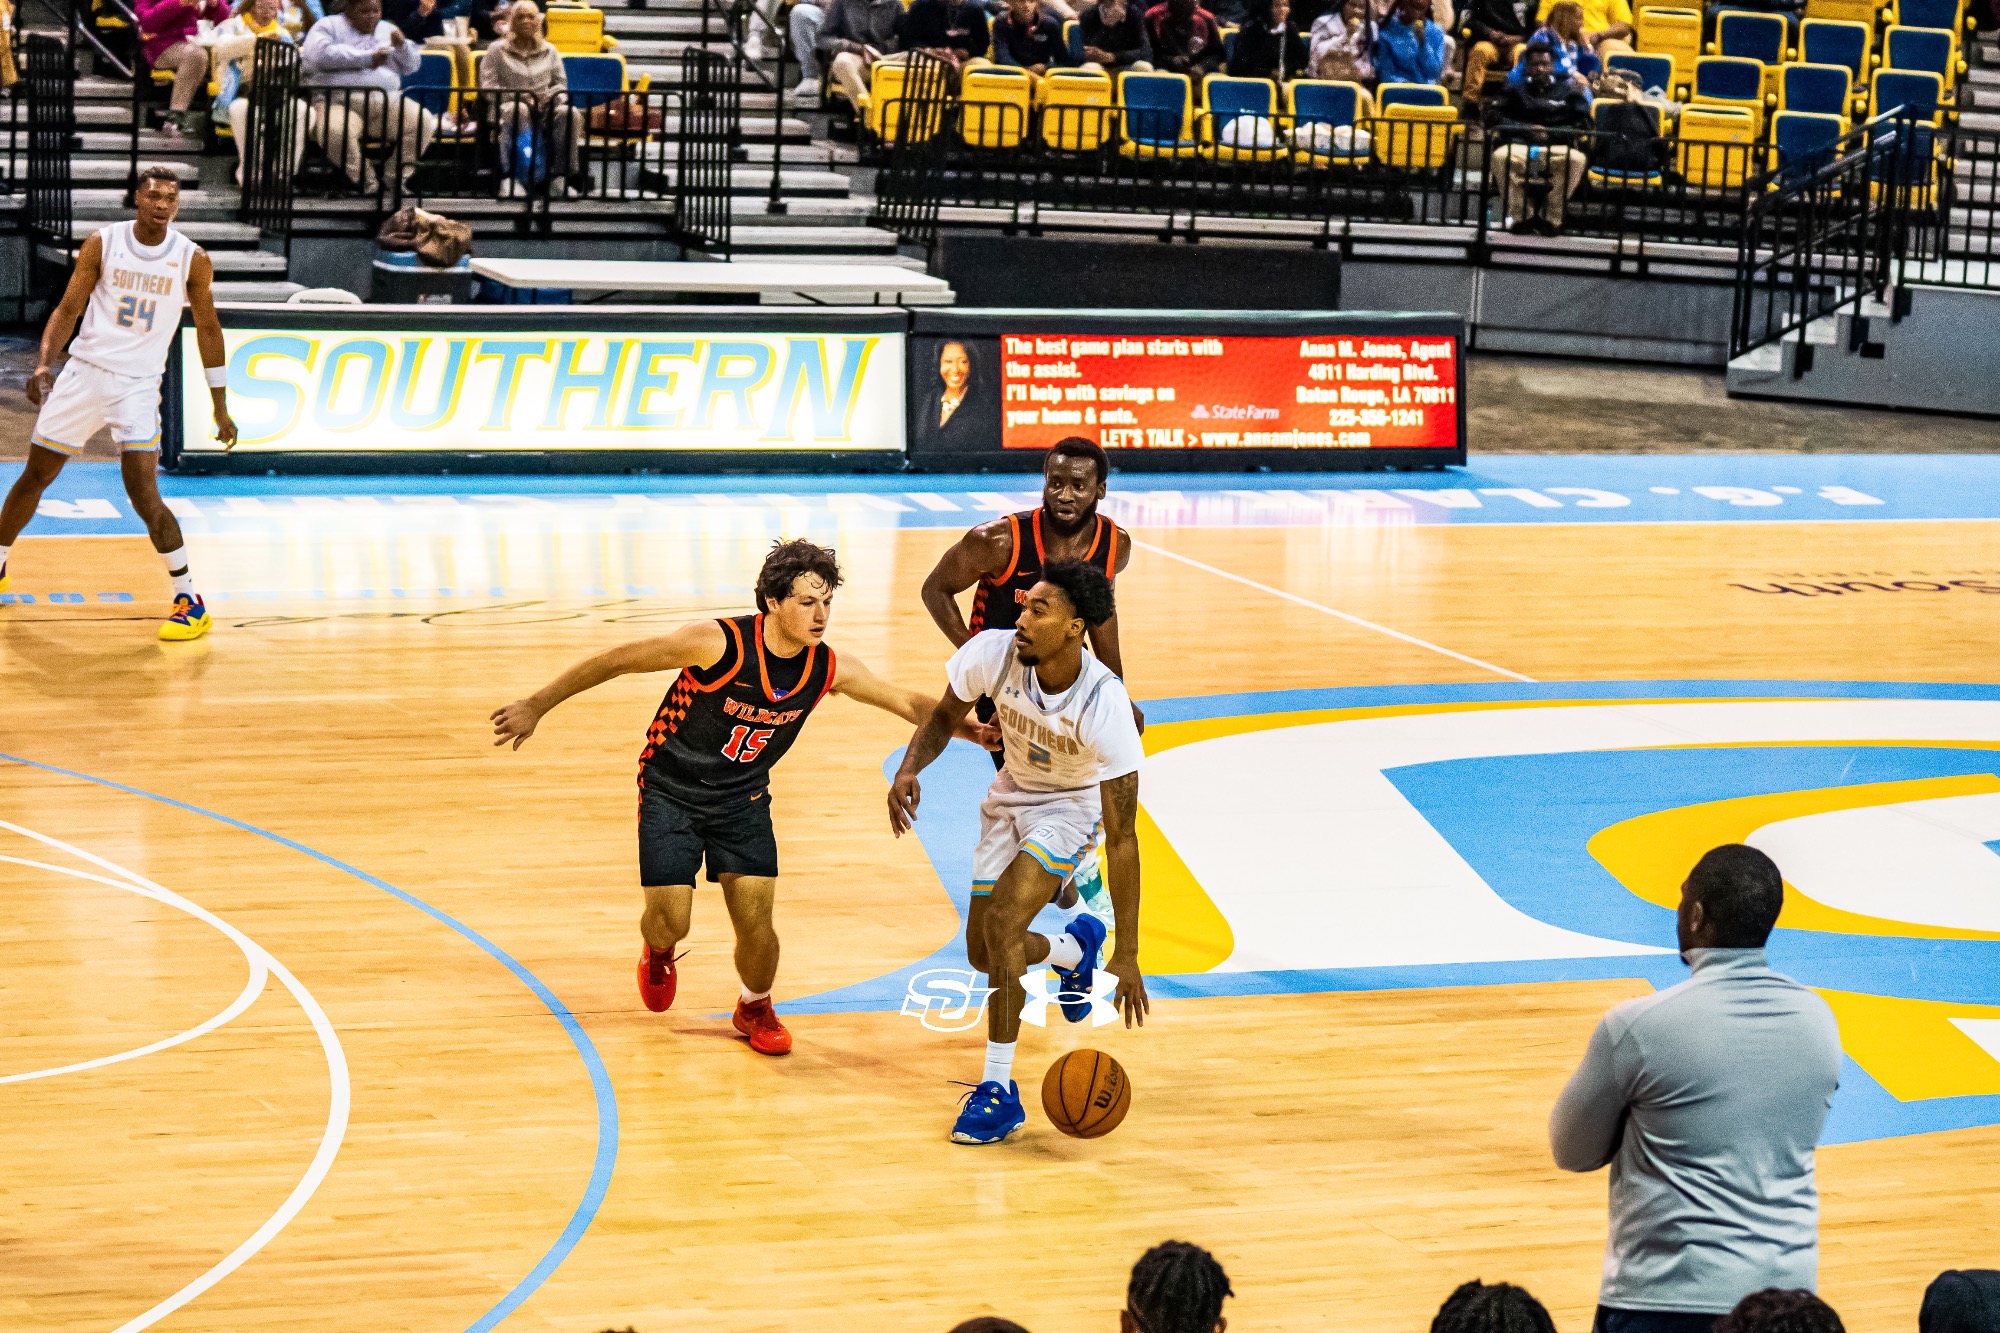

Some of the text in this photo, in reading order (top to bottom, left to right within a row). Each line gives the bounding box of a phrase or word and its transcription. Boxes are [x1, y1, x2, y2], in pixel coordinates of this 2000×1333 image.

[112, 268, 173, 296] SOUTHERN
[116, 295, 157, 332] 24
[1005, 338, 1223, 359] The best game plan starts with
[1299, 340, 1451, 361] Anna M. Jones, Agent
[1005, 361, 1082, 378] the assist.
[1346, 363, 1401, 384] Harding
[1403, 363, 1439, 381] Blvd.
[215, 334, 881, 444] SOUTHERN
[1006, 384, 1176, 405] I'll help with savings on
[1296, 386, 1455, 406] Baton Rouge, LA 70811
[1006, 406, 1138, 428] your home & auto.
[1100, 429, 1144, 446] LET'S
[1146, 429, 1185, 446] TALK
[1200, 428, 1371, 449] www.annamjones.com
[723, 697, 803, 726] WILDCATS
[1000, 703, 1080, 756] SOUTHERN
[721, 725, 775, 762] 15
[1027, 741, 1052, 773] 2
